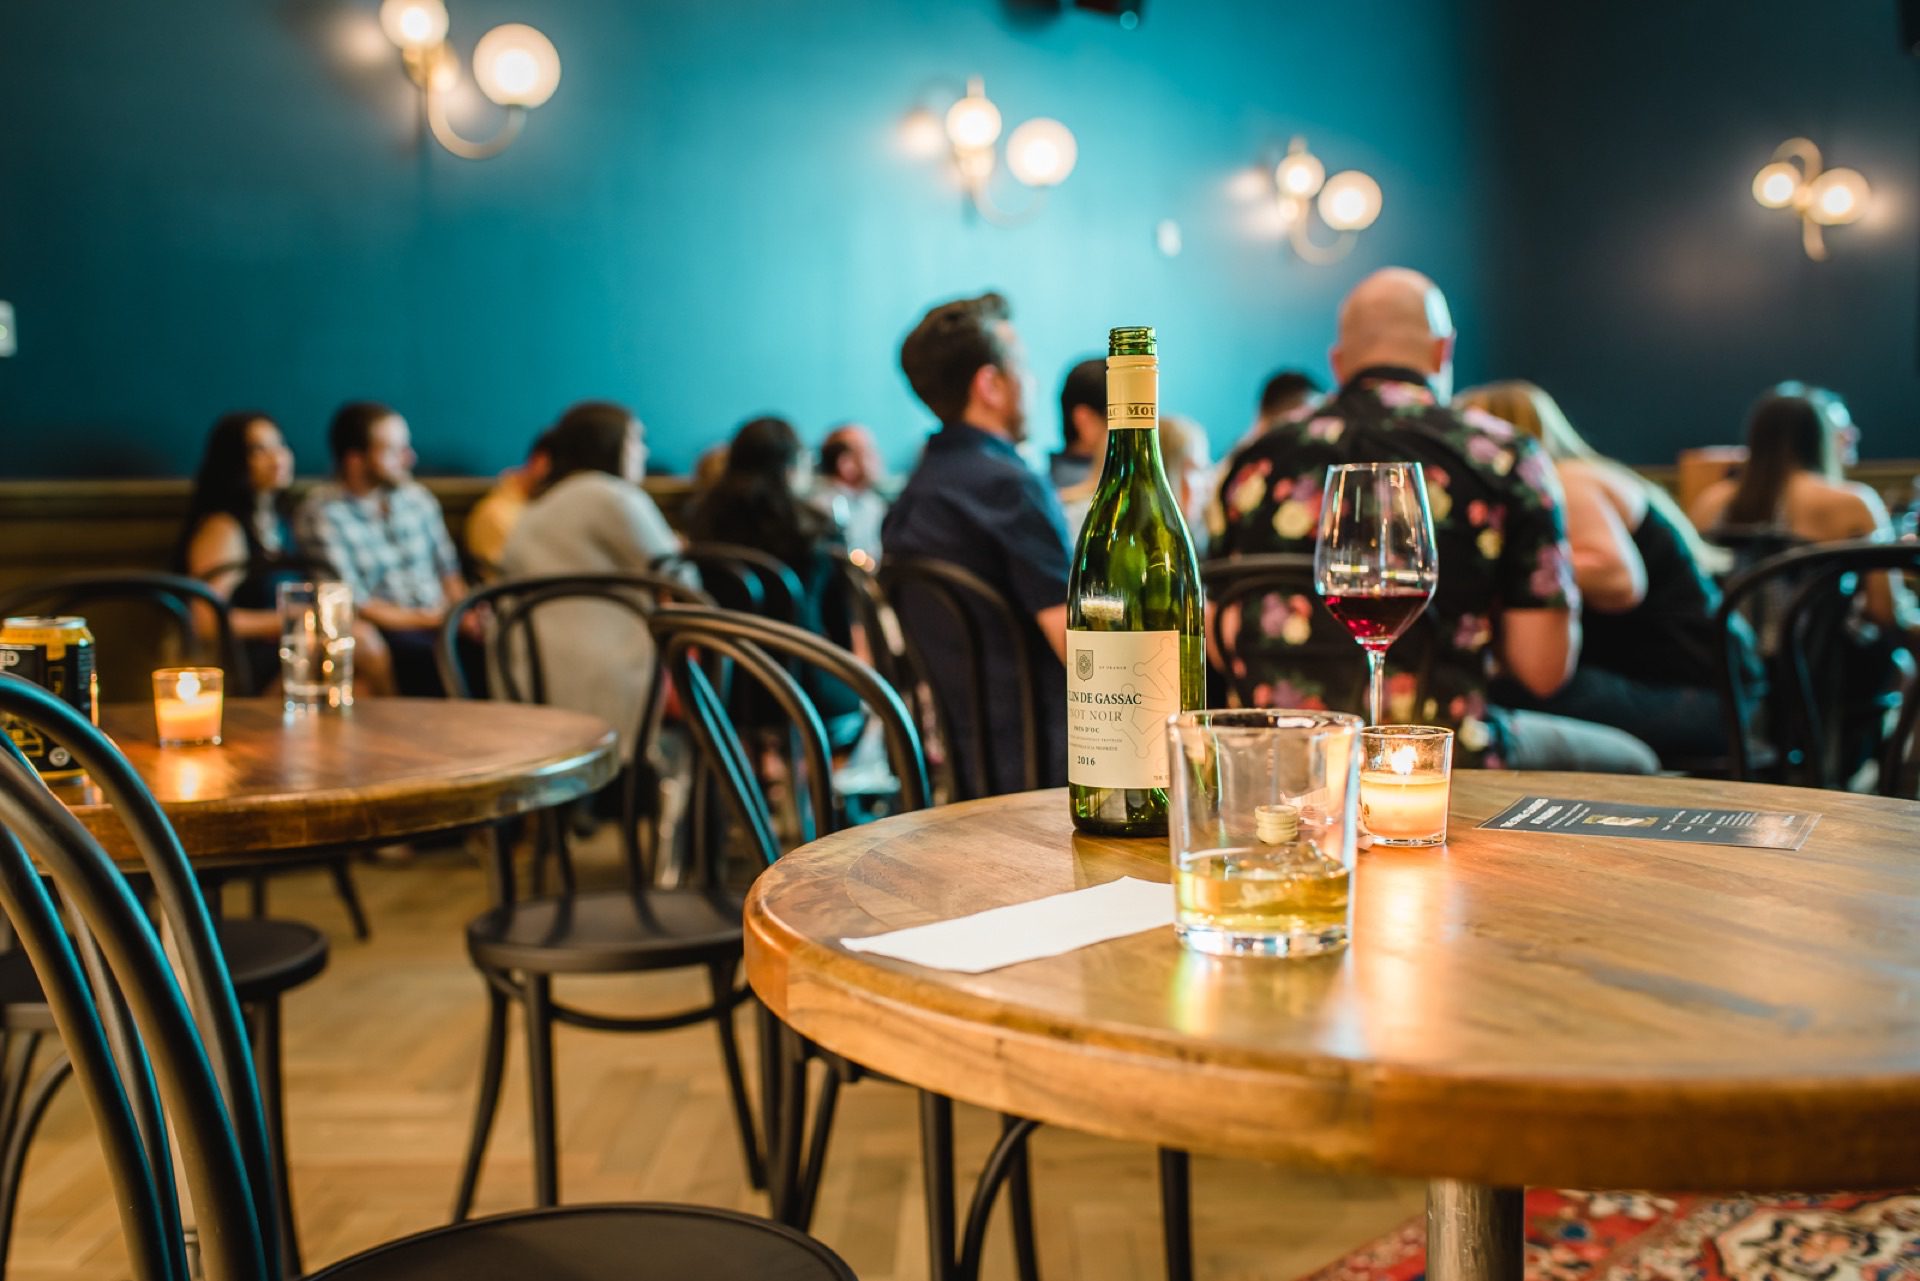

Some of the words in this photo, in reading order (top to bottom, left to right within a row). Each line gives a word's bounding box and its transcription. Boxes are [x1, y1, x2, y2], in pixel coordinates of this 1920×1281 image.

[1080, 691, 1093, 704] DE
[1095, 692, 1142, 705] GASSAC
[1090, 710, 1123, 722] NOIR
[1077, 755, 1096, 766] 2016
